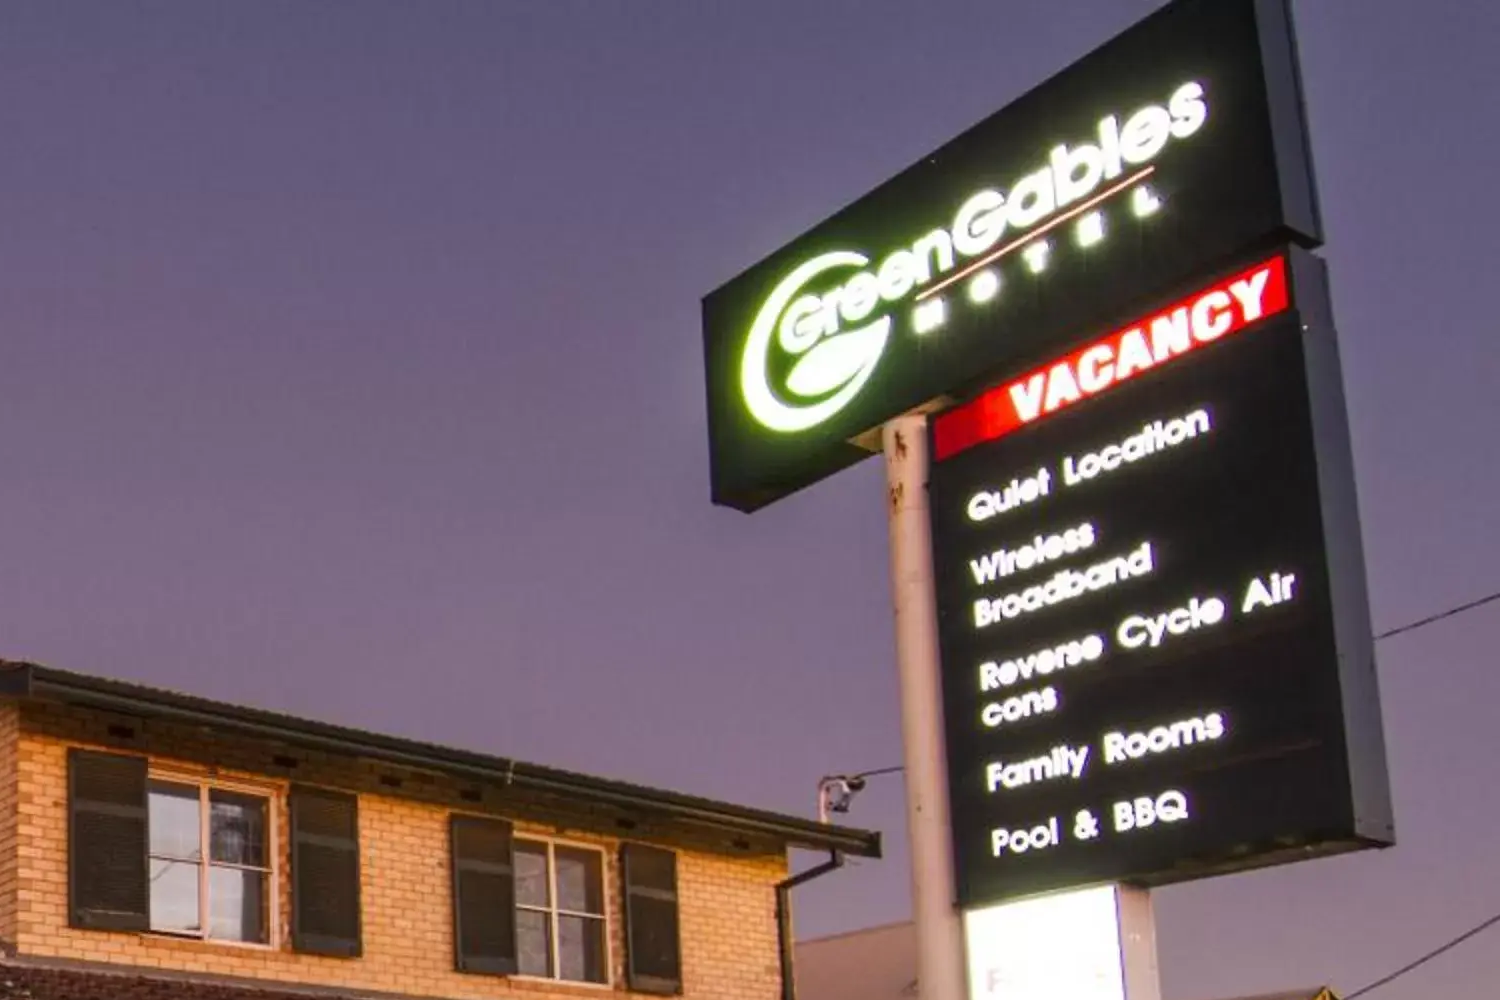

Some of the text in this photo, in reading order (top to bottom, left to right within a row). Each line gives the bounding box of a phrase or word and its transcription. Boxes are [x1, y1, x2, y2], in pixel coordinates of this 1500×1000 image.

[1008, 268, 1272, 422] VACANCY
[967, 407, 1210, 521] Quiet Location
[971, 522, 1095, 584] Wireless
[974, 542, 1154, 628] Broadband
[980, 571, 1296, 691] Reverse Cycle Air
[981, 687, 1057, 727] cons
[987, 712, 1225, 792] Family Rooms
[991, 790, 1188, 857] Pool & BBQ
